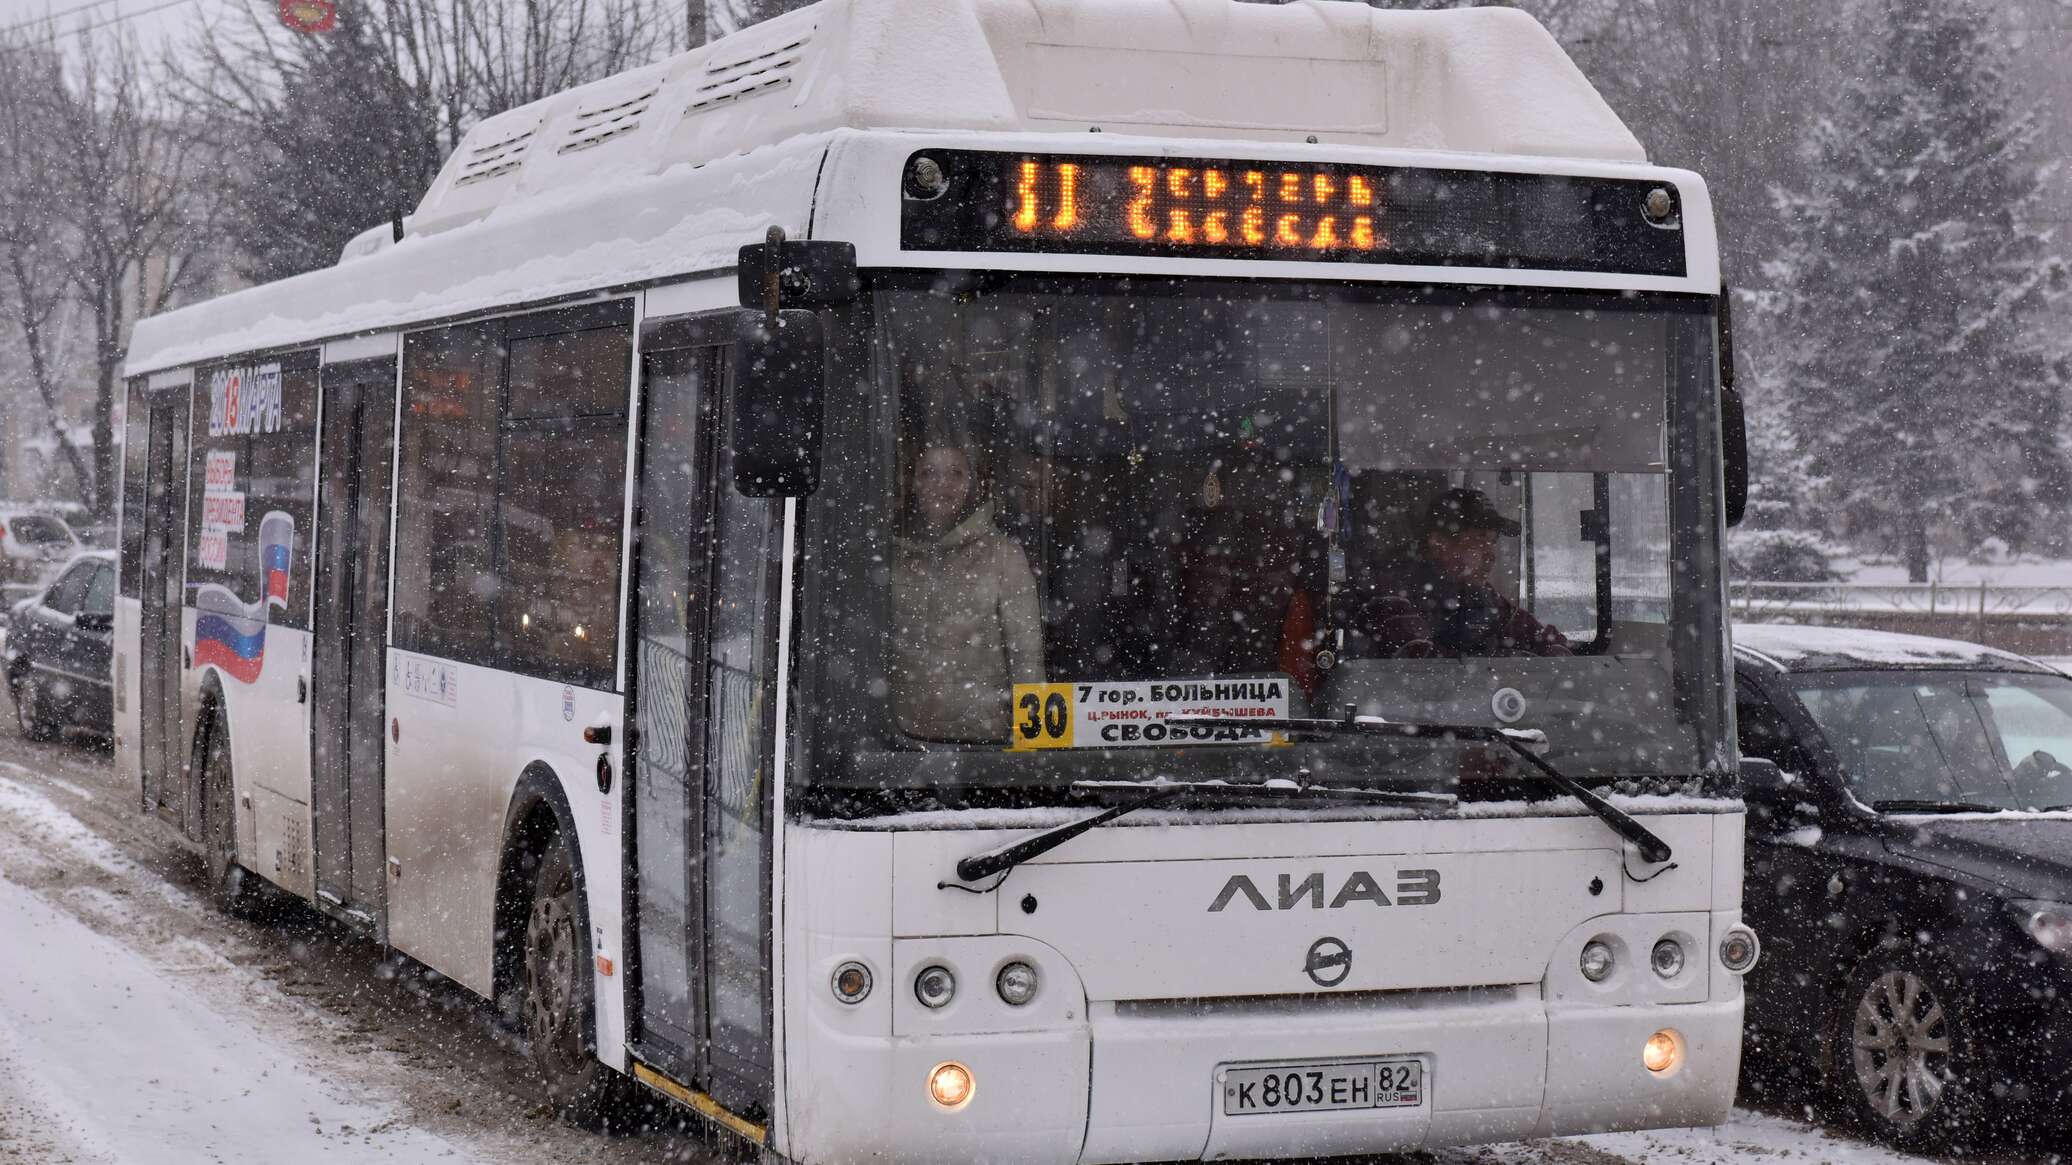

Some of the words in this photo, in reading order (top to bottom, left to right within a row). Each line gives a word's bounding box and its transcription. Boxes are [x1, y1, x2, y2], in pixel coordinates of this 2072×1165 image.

[1078, 686, 1092, 704] 7
[1098, 689, 1144, 707] гор.
[1150, 682, 1283, 703] БОЛЬНИЦА
[1018, 692, 1068, 740] 30
[1101, 722, 1262, 741] СВОБОДА
[1207, 869, 1442, 912] ЛИАЗ
[1379, 1066, 1411, 1092] 82
[1376, 1091, 1400, 1103] RUS
